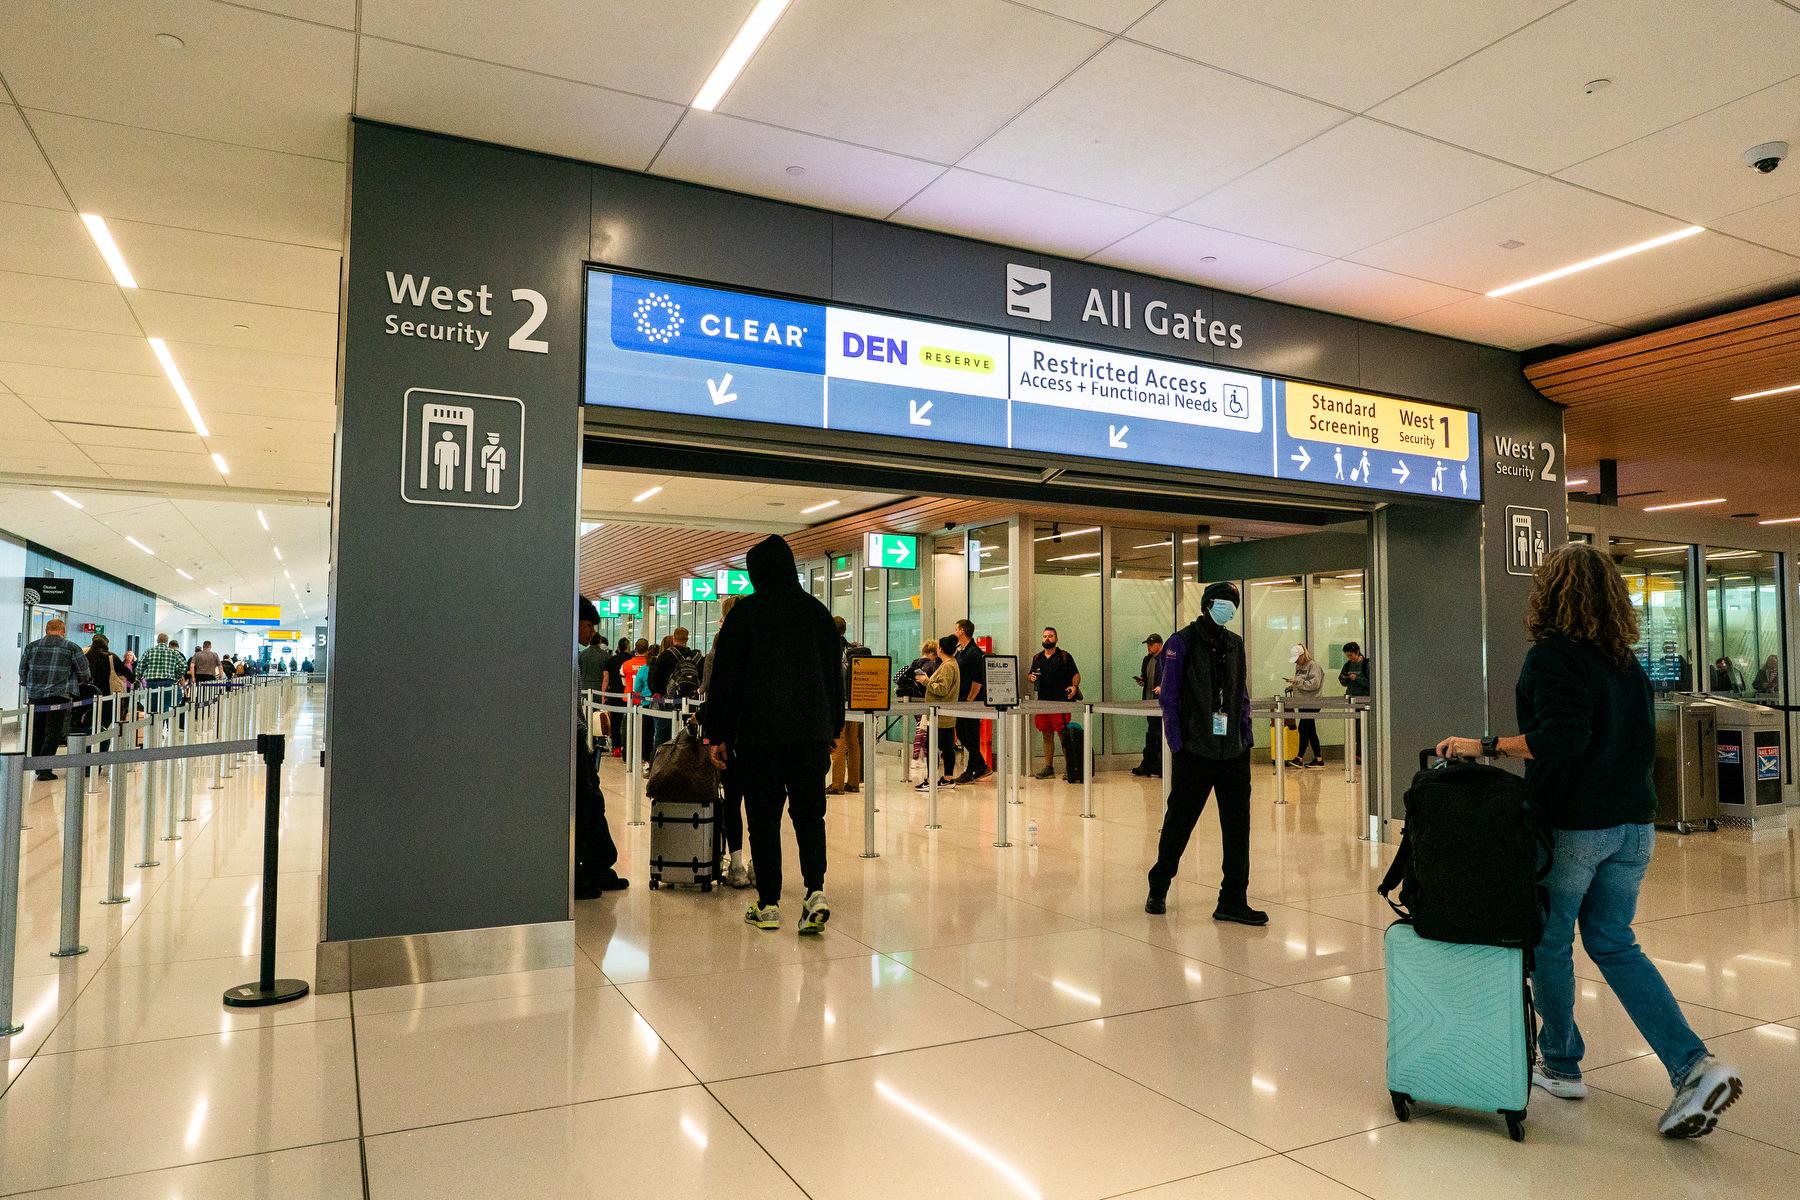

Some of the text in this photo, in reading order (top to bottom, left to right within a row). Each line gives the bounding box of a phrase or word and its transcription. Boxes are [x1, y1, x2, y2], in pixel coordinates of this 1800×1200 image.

[385, 270, 549, 354] West 2
[385, 314, 490, 351] Security
[1081, 288, 1243, 349] All Gates
[842, 331, 991, 370] DEN RESERVE
[1020, 371, 1218, 413] Access + Functional Needs
[1033, 350, 1208, 395] Restricted Access
[1309, 414, 1435, 449] Screening Security
[1312, 394, 1451, 449] Standard West 1
[1494, 435, 1557, 482] West 2
[1496, 461, 1535, 482] Security
[318, 634, 327, 646] 3
